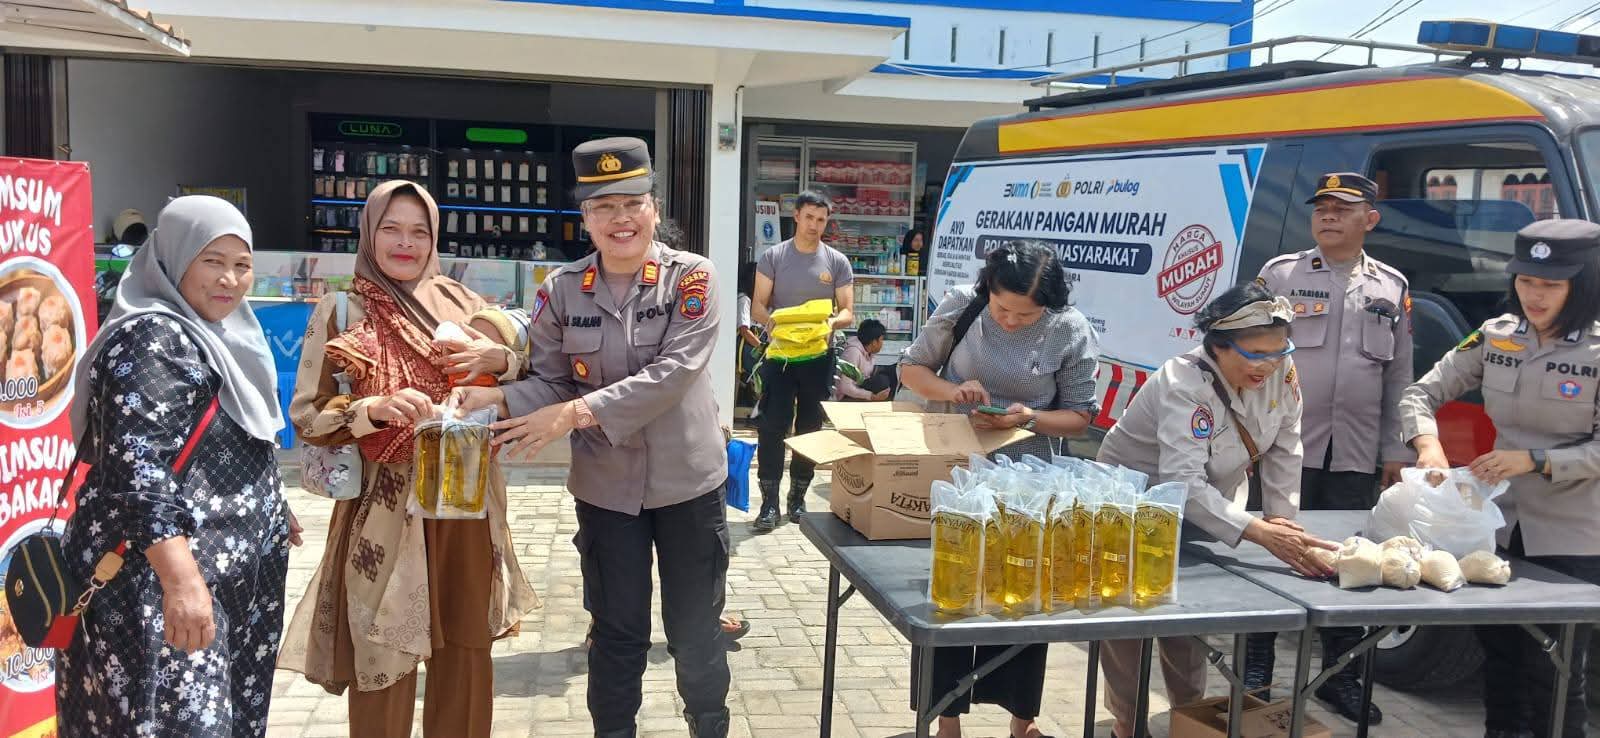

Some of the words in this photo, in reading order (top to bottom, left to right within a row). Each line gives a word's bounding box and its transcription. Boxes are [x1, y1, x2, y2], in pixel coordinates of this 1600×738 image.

[351, 122, 392, 134] LUNA
[1074, 181, 1104, 195] POLRI
[1113, 178, 1140, 196] bulog
[950, 220, 965, 235] AYO
[976, 210, 1034, 230] GERAKAN
[1035, 211, 1099, 234] PANGAN
[1099, 212, 1167, 237] MURAH
[938, 235, 974, 252] DAPATKAN
[1173, 230, 1205, 253] HARGA
[1161, 248, 1218, 293] MURAH
[1484, 352, 1523, 369] JESSY
[1545, 361, 1598, 378] POLRI
